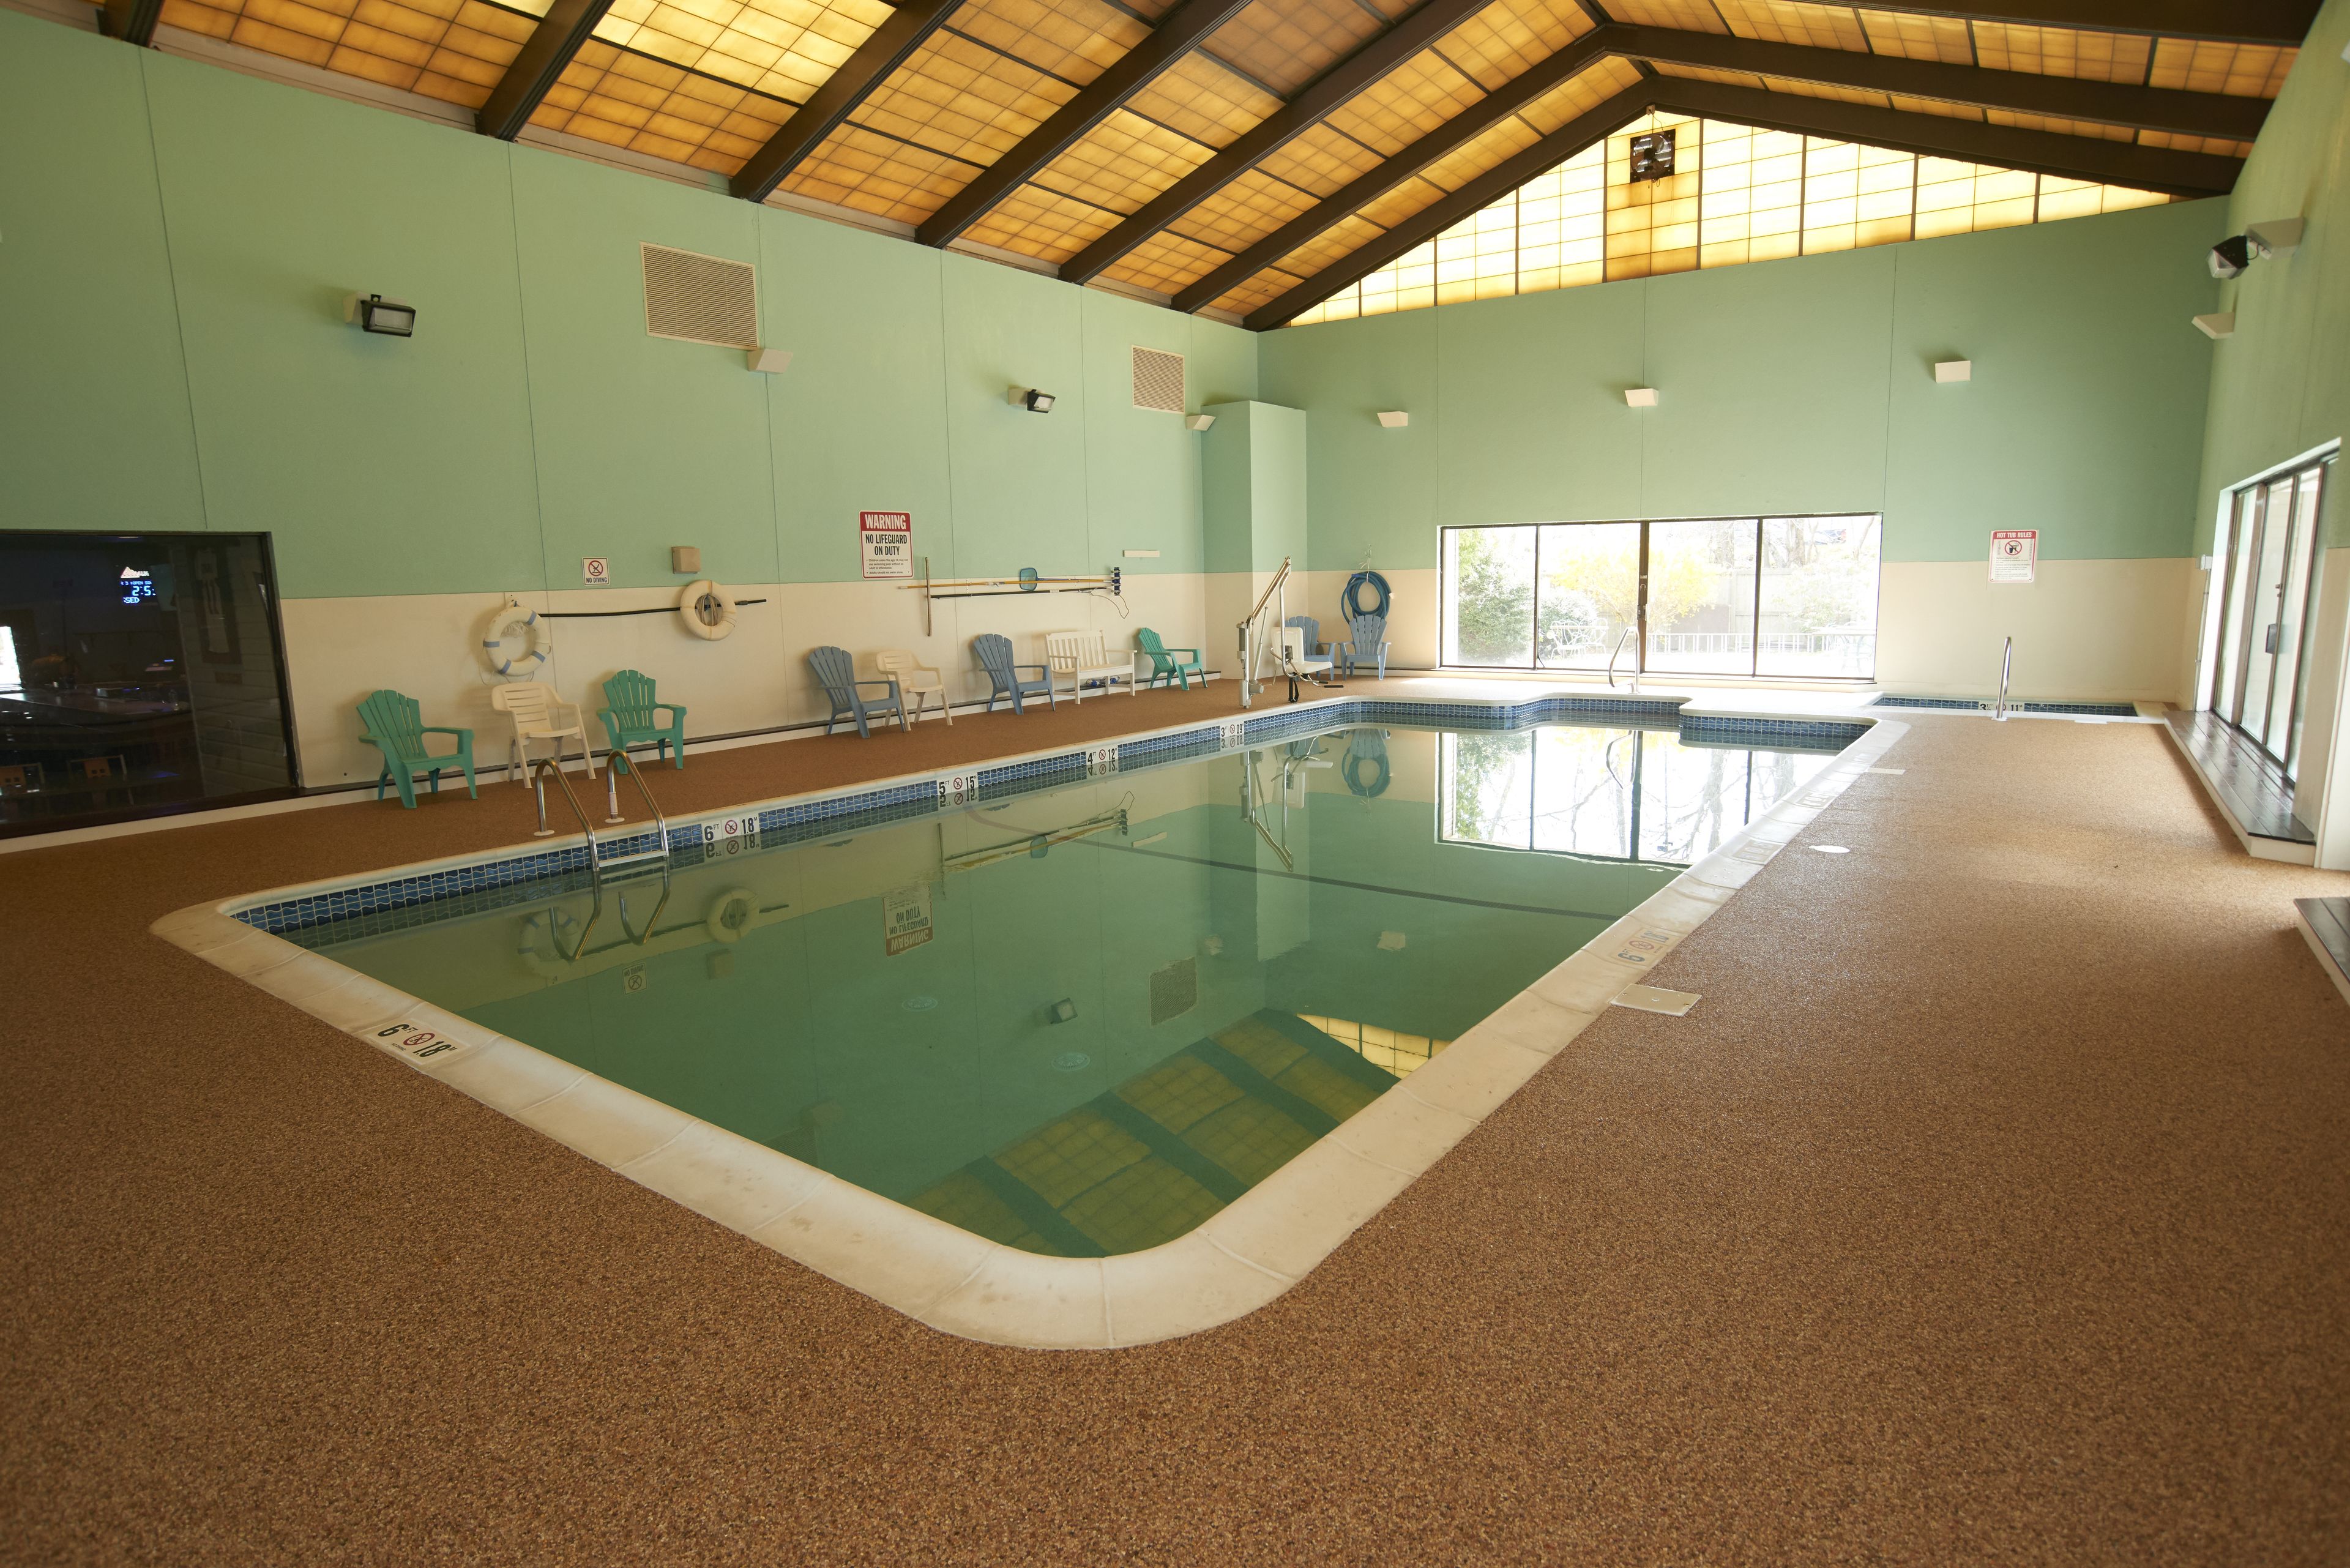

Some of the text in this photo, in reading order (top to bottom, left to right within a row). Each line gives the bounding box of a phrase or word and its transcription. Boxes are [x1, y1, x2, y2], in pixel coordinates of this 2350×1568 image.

[865, 514, 906, 529] WARNING
[865, 534, 907, 543] NO LIFEGUARD
[874, 546, 900, 556] ON DUTY
[1222, 727, 1225, 737] 3
[1087, 753, 1093, 764] 4
[939, 782, 946, 795] 5
[704, 826, 714, 841] 6
[1618, 953, 1645, 962] 6
[378, 1024, 409, 1037] 6
